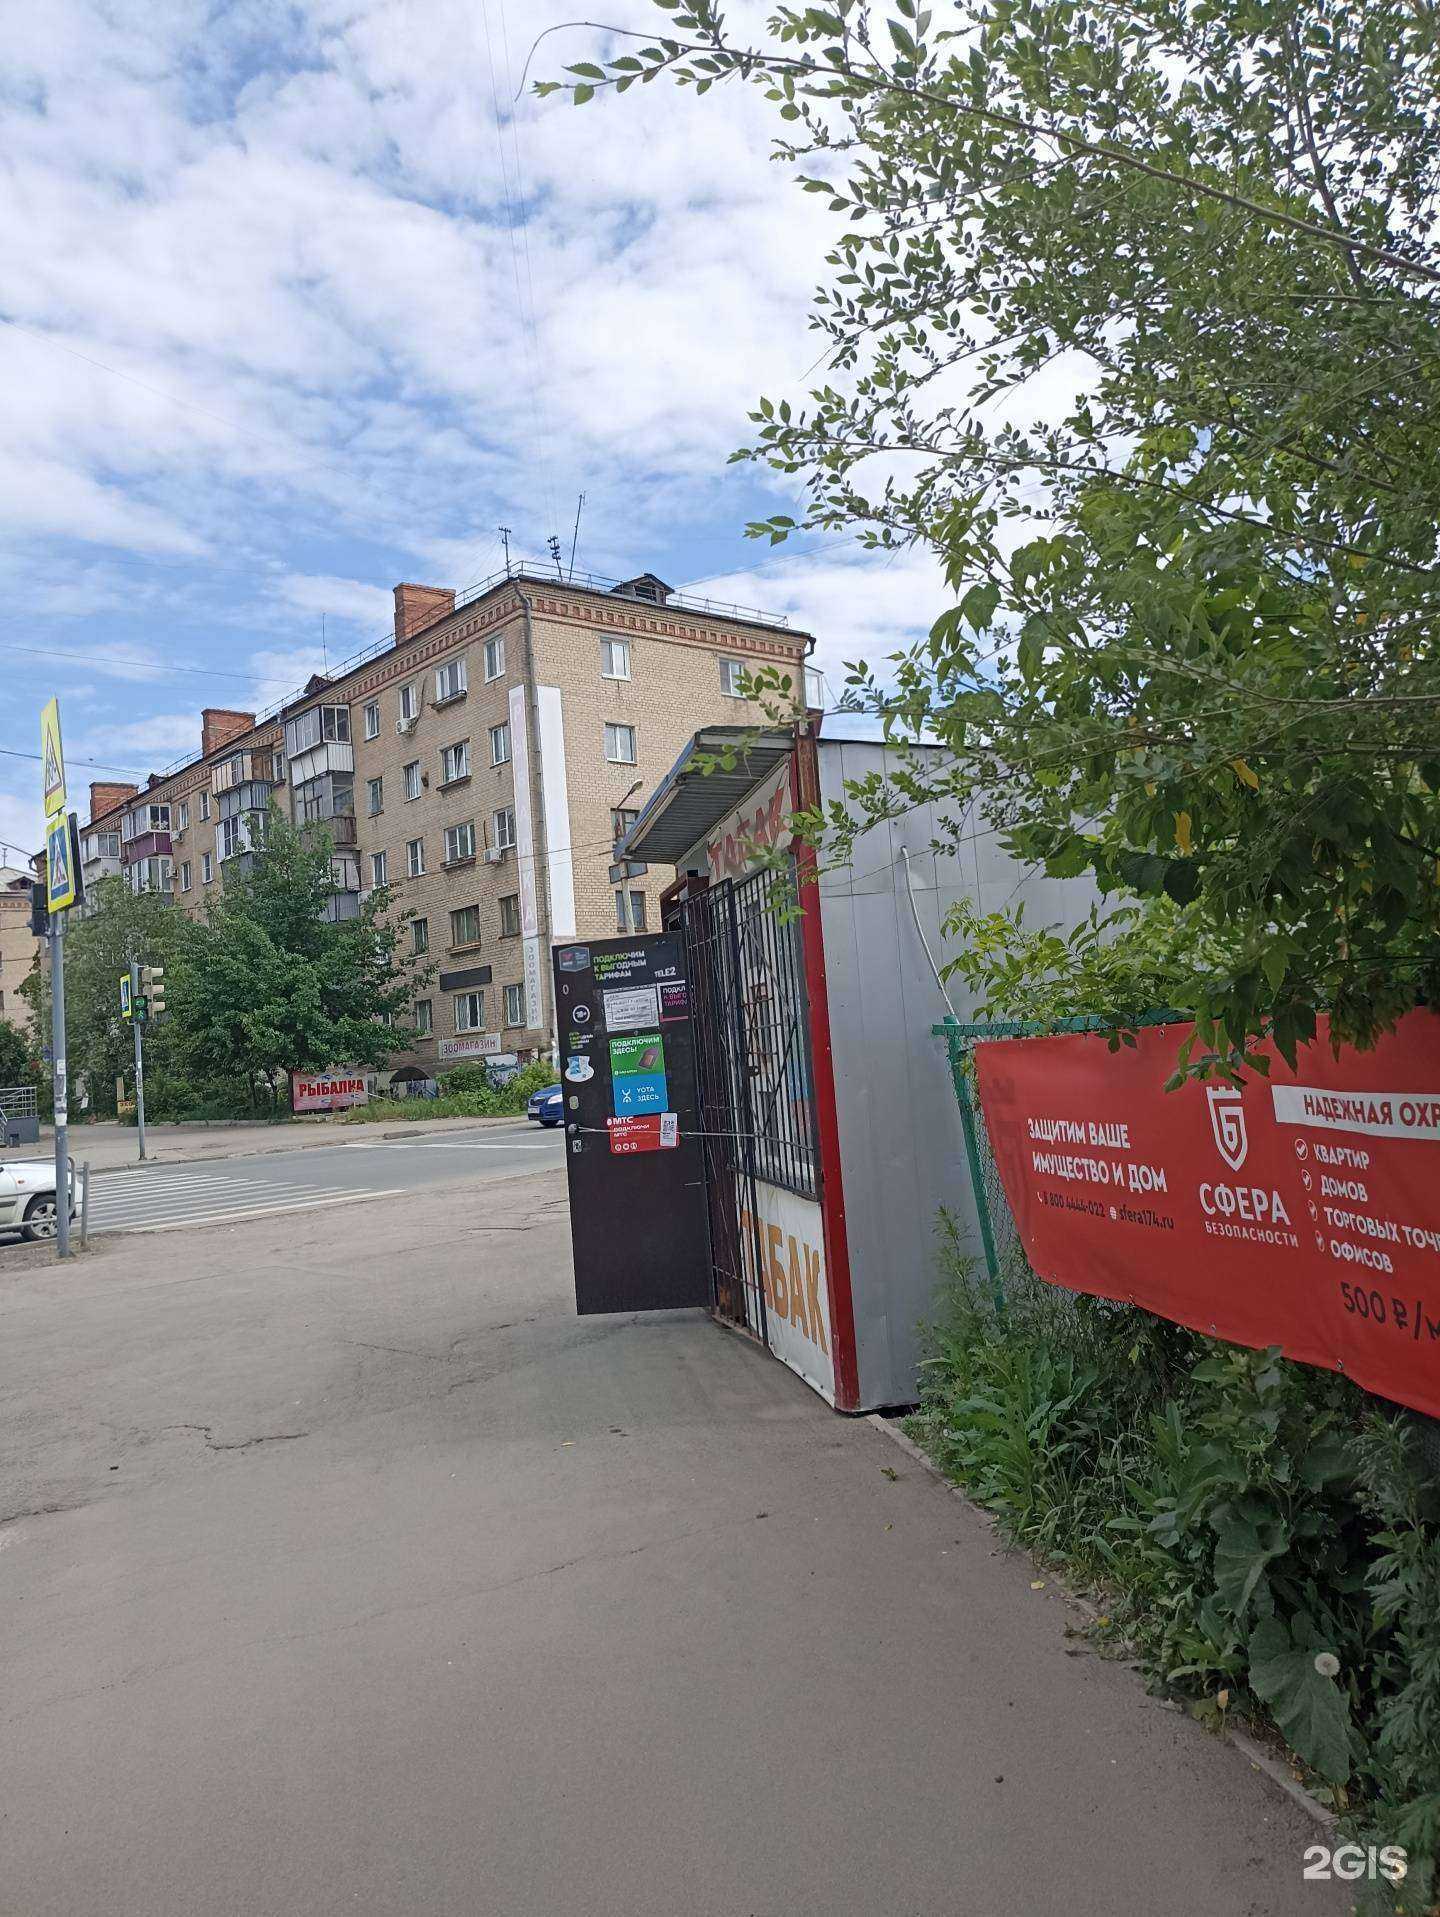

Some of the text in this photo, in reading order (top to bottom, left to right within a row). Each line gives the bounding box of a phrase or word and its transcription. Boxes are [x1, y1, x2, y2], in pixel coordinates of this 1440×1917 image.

[593, 950, 645, 963] ПОДКЛЮЧИМ
[601, 959, 647, 972] ВЫГОДНЫМ
[595, 970, 632, 981] ТАРИФАМ
[654, 966, 677, 978] TELE2
[443, 1038, 496, 1054] ЗООМАГАЗИН
[611, 1036, 660, 1048] ПОДКЛЮЧИМ
[298, 1079, 365, 1098] РЫБАЛКА
[613, 1116, 634, 1125] МТС
[1303, 1094, 1394, 1125] НАДЕЖНАЯ
[1027, 1118, 1131, 1149] ЗАЩИТИМ ВАШЕ
[1313, 1143, 1370, 1170] КВАРТИР
[1032, 1151, 1168, 1194] ИМУЩЕСТВО И ДОМ
[1321, 1174, 1368, 1202] ДОМОВ
[1119, 1204, 1175, 1230] sfera174.ru
[1199, 1183, 1291, 1226] СФЕРА
[1204, 1220, 1299, 1248] БЕЗОПАСНОСТИ
[1323, 1206, 1440, 1252] ТОРГОВЫХ ТОЧ
[1330, 1240, 1393, 1273] ОФИСОВ
[1341, 1281, 1386, 1324] 500
